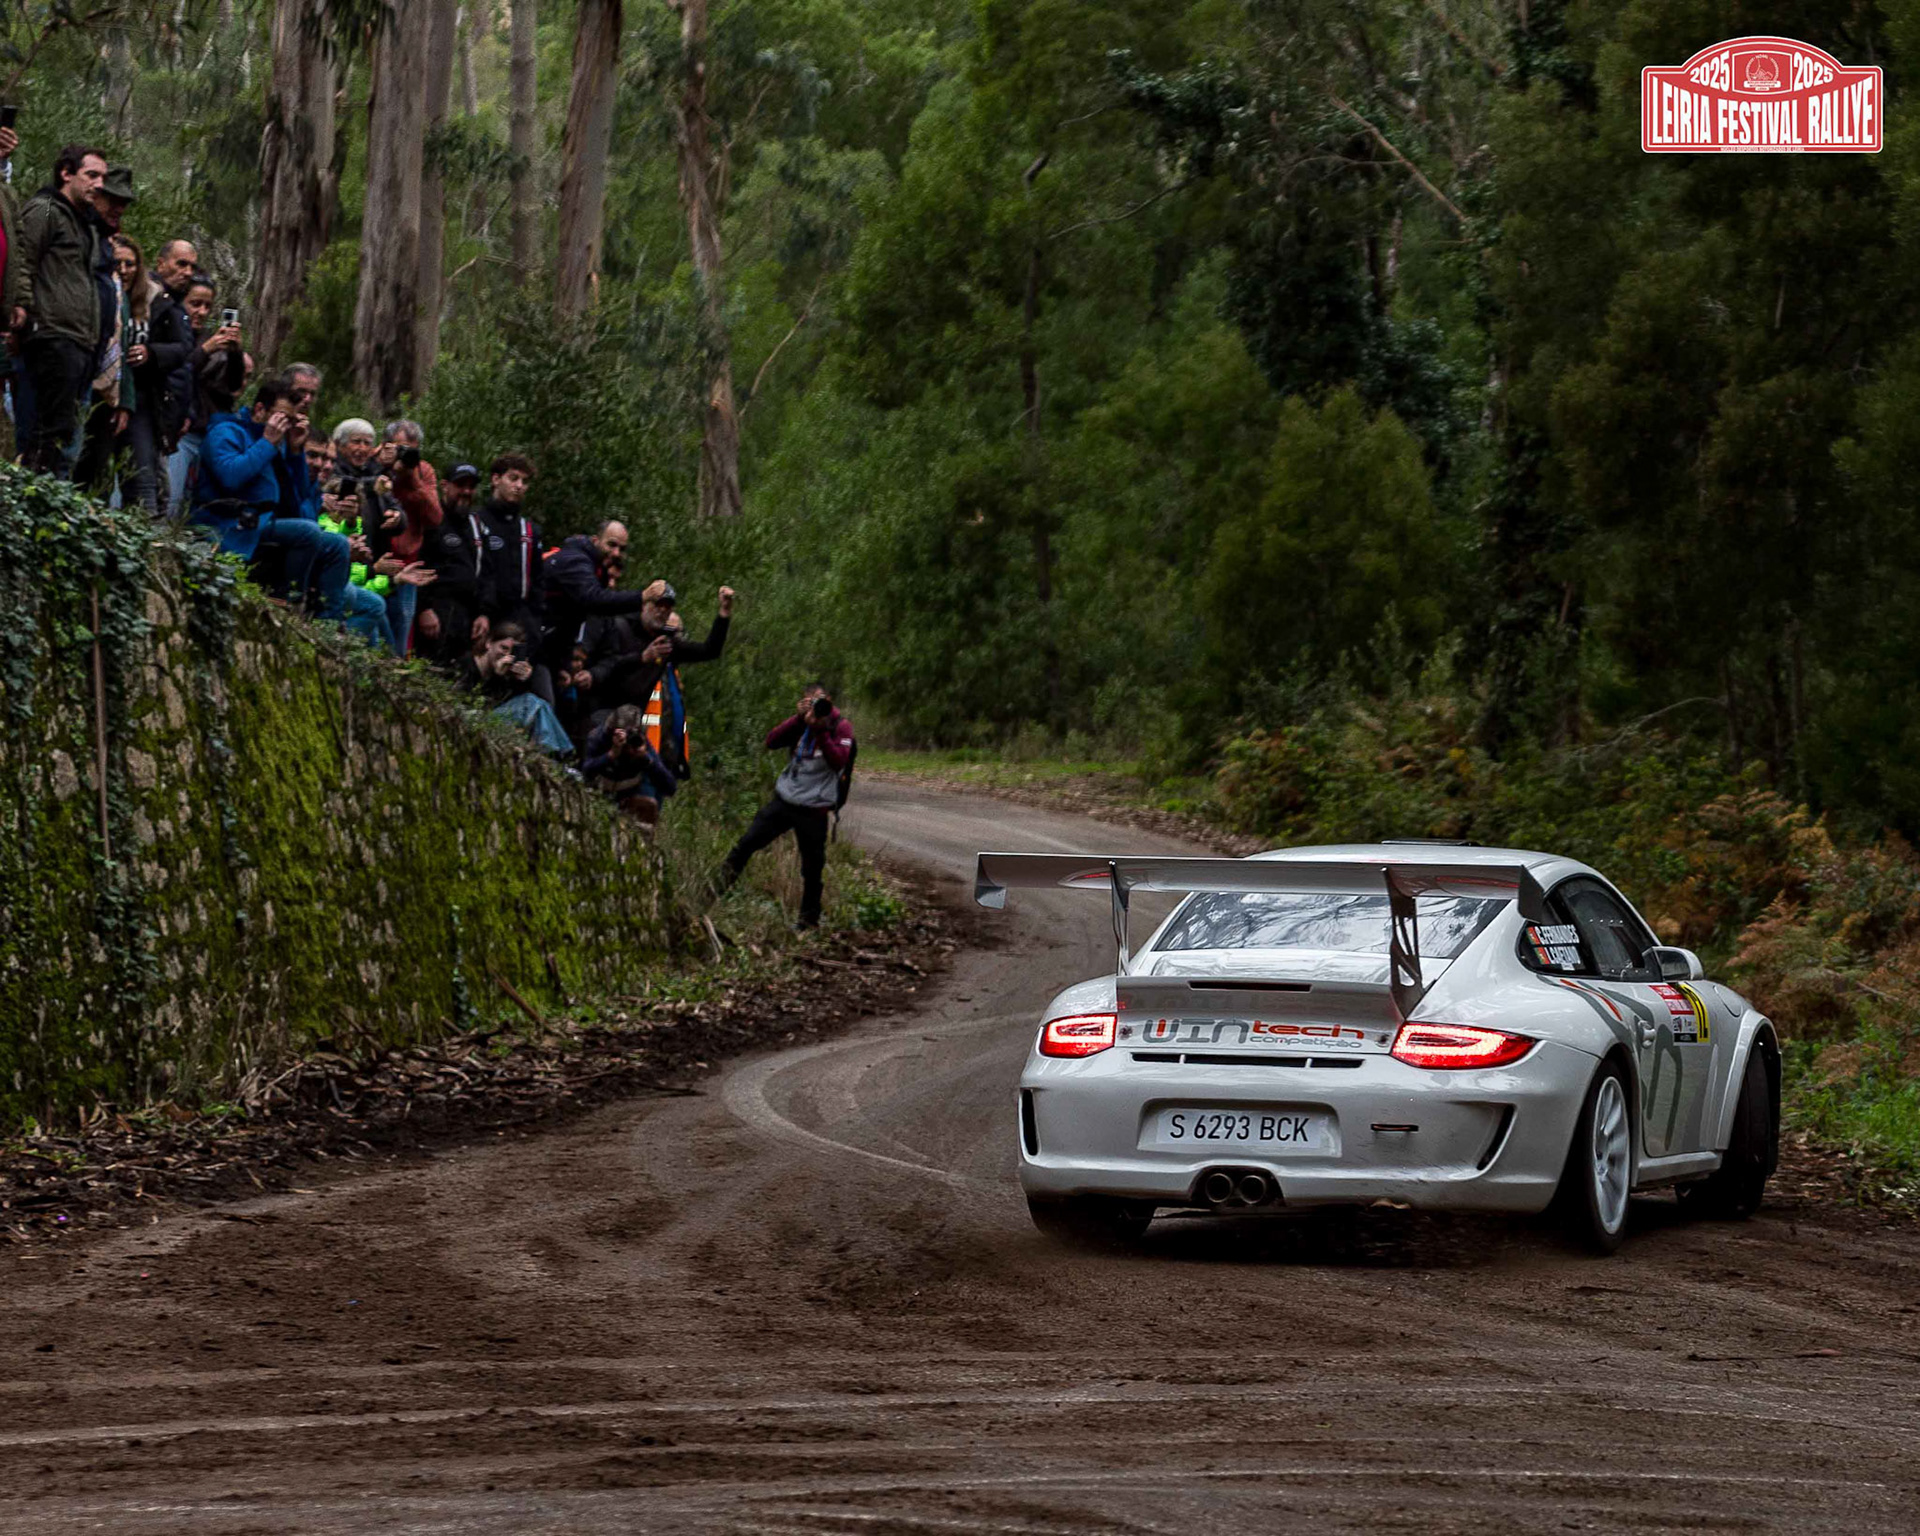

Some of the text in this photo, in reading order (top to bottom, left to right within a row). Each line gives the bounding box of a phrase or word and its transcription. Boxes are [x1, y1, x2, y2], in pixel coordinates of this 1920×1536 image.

[1170, 1114, 1309, 1142] S 6293 BCK
